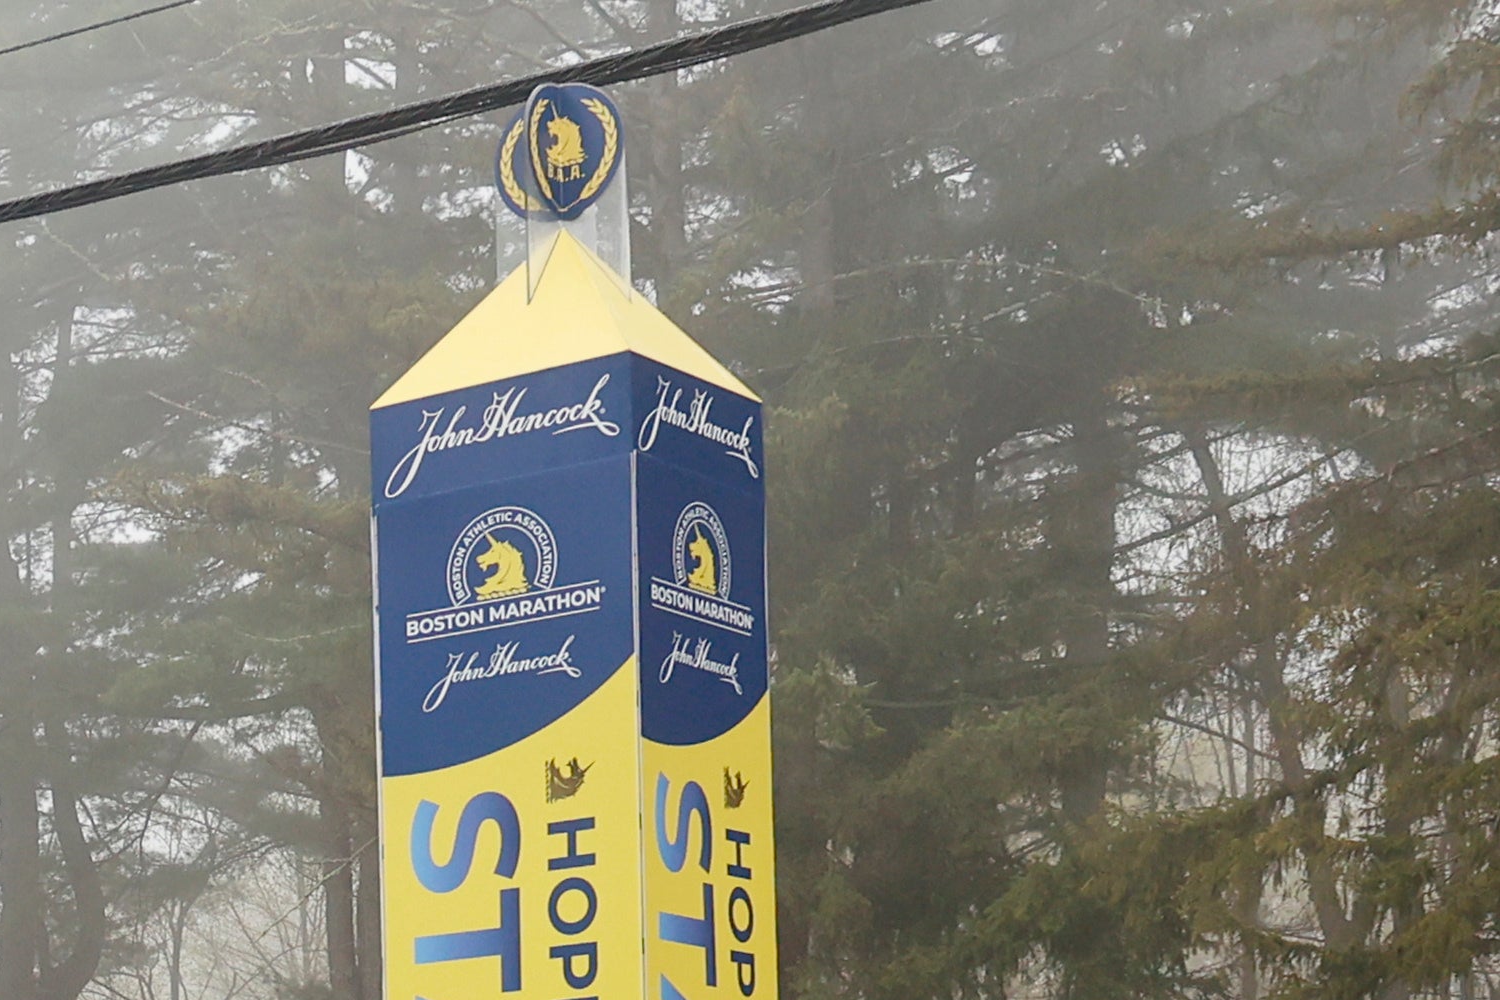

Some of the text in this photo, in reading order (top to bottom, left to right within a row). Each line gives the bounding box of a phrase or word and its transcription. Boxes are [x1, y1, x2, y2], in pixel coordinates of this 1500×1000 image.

[385, 373, 621, 498] John Hancock
[638, 375, 759, 479] John Hancock
[452, 512, 553, 600] BOSTON ATHLETIC ASSOCIATION
[406, 586, 600, 637] BOSTON MARATHON
[651, 583, 753, 630] BOSTON MARATHON
[422, 635, 582, 713] John Hancock
[659, 630, 743, 696] John Hancock
